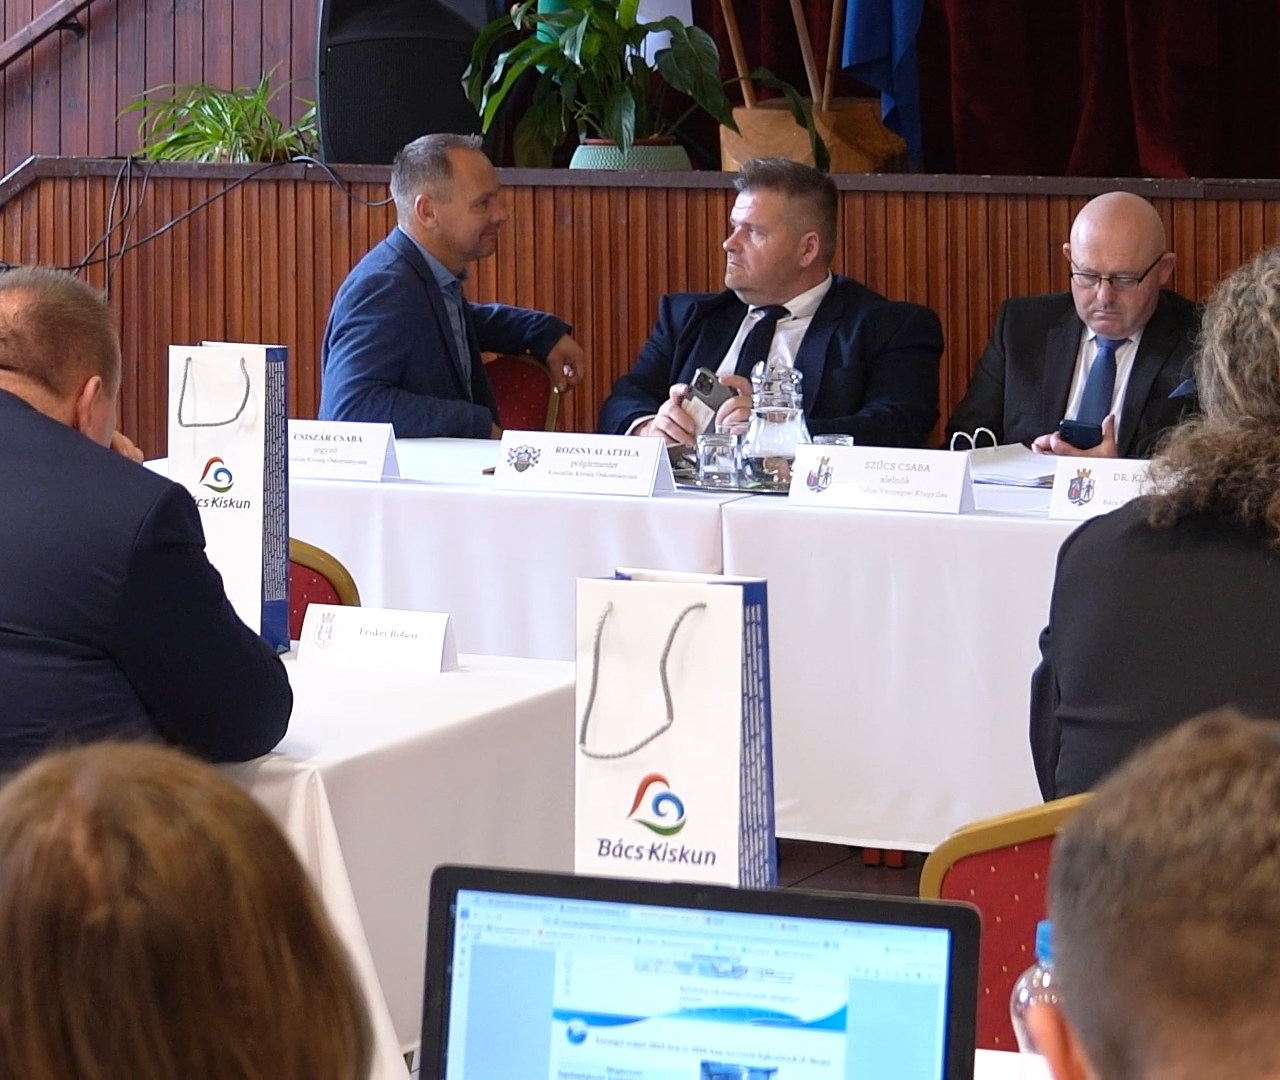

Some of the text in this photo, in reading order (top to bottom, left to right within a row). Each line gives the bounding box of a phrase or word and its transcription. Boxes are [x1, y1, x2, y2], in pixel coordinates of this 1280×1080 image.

[555, 446, 639, 457] ROZSNYAI ATTILA
[898, 462, 931, 472] CSABA
